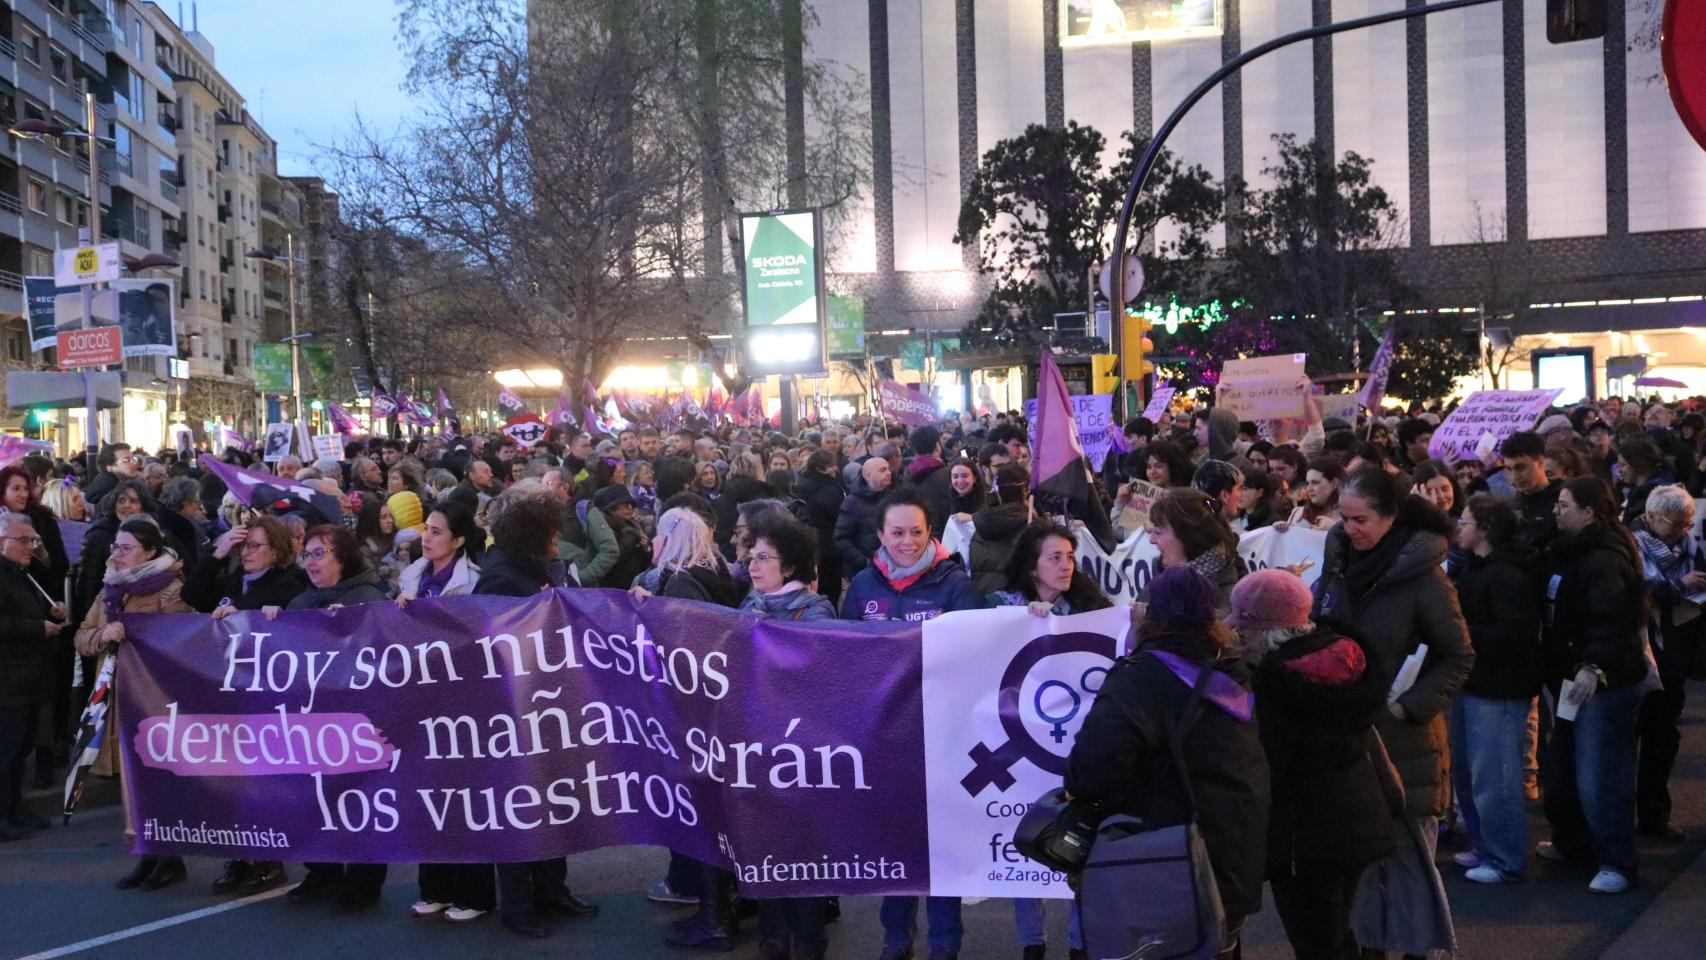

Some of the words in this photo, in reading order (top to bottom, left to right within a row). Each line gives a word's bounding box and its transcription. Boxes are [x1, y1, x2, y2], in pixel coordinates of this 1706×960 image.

[500, 393, 523, 411] CGT
[560, 411, 579, 429] CG
[1458, 427, 1471, 436] EL
[905, 612, 927, 621] UGT
[219, 631, 340, 714] Hoy
[349, 640, 463, 690] son
[474, 623, 730, 700] nuestros
[146, 701, 401, 773] derechos,
[419, 686, 679, 760] mañana
[685, 717, 872, 792] serán
[311, 771, 399, 833] los
[416, 759, 698, 832] vuestros
[143, 818, 290, 849] #luchafeminista
[988, 868, 1002, 881] de
[1004, 868, 1068, 886] Zaragoz
